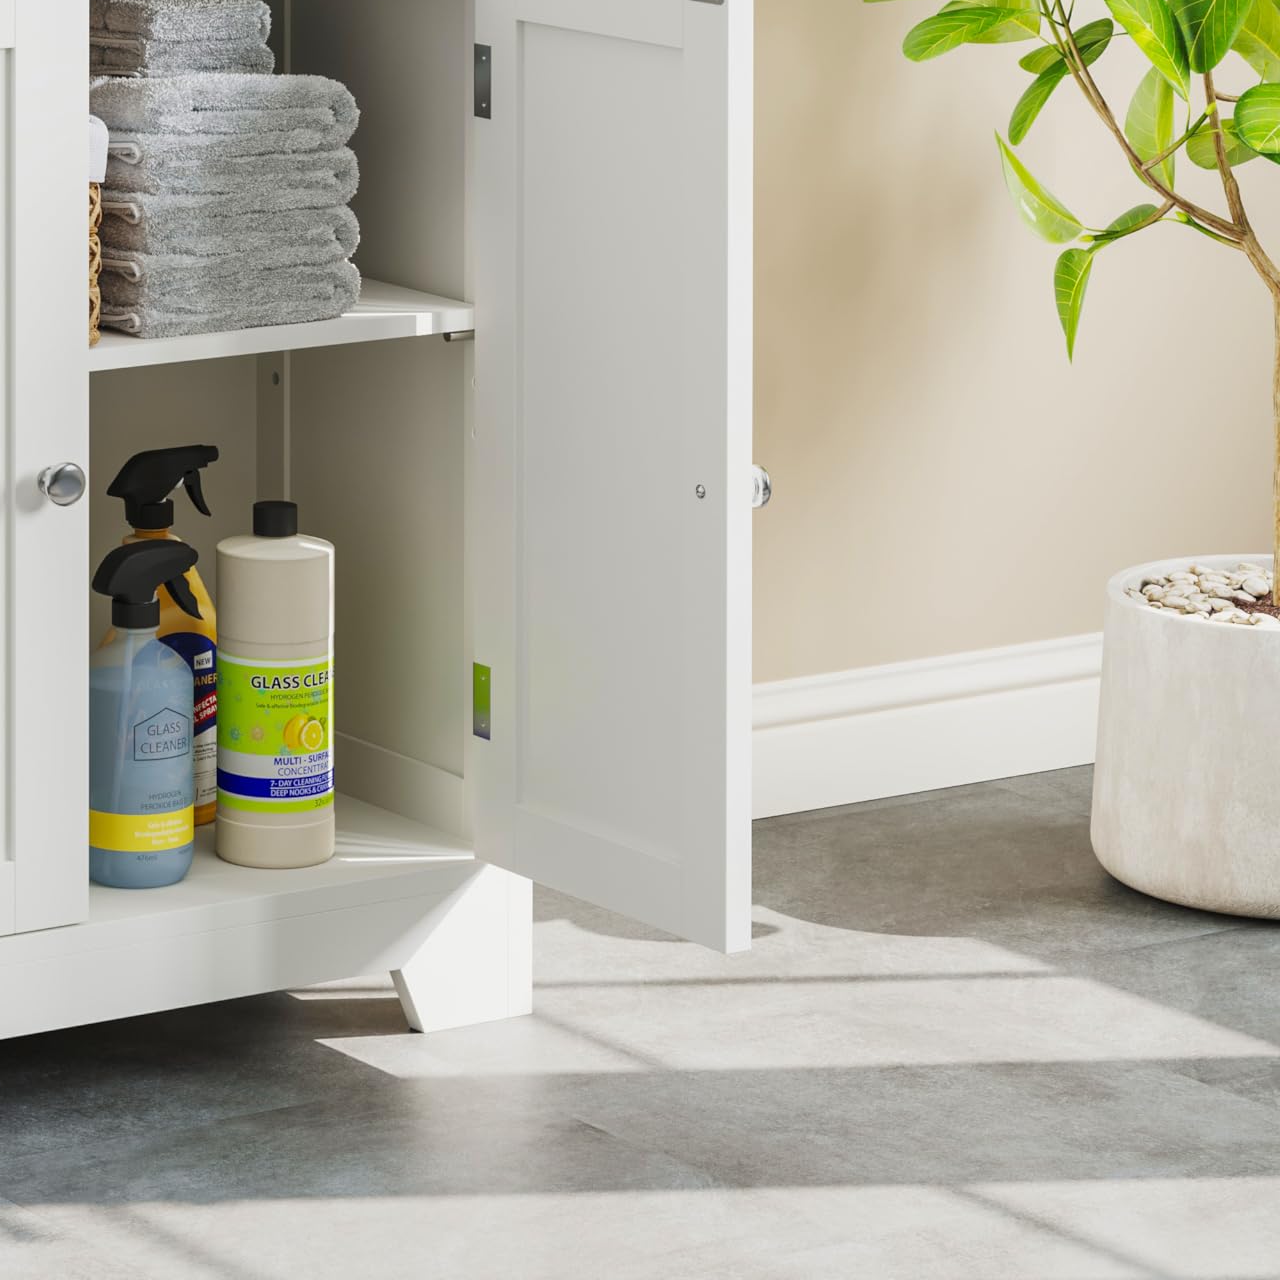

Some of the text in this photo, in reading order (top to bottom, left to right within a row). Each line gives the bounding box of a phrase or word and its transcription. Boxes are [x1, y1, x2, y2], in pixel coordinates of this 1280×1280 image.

[195, 656, 211, 667] NEW
[251, 675, 300, 690] GLASS
[146, 721, 181, 736] GLASS
[140, 737, 187, 754] CLEANER
[273, 756, 302, 766] MULTI
[278, 779, 292, 787] DAY
[271, 789, 288, 797] DEEP
[289, 786, 311, 796] NOOKS
